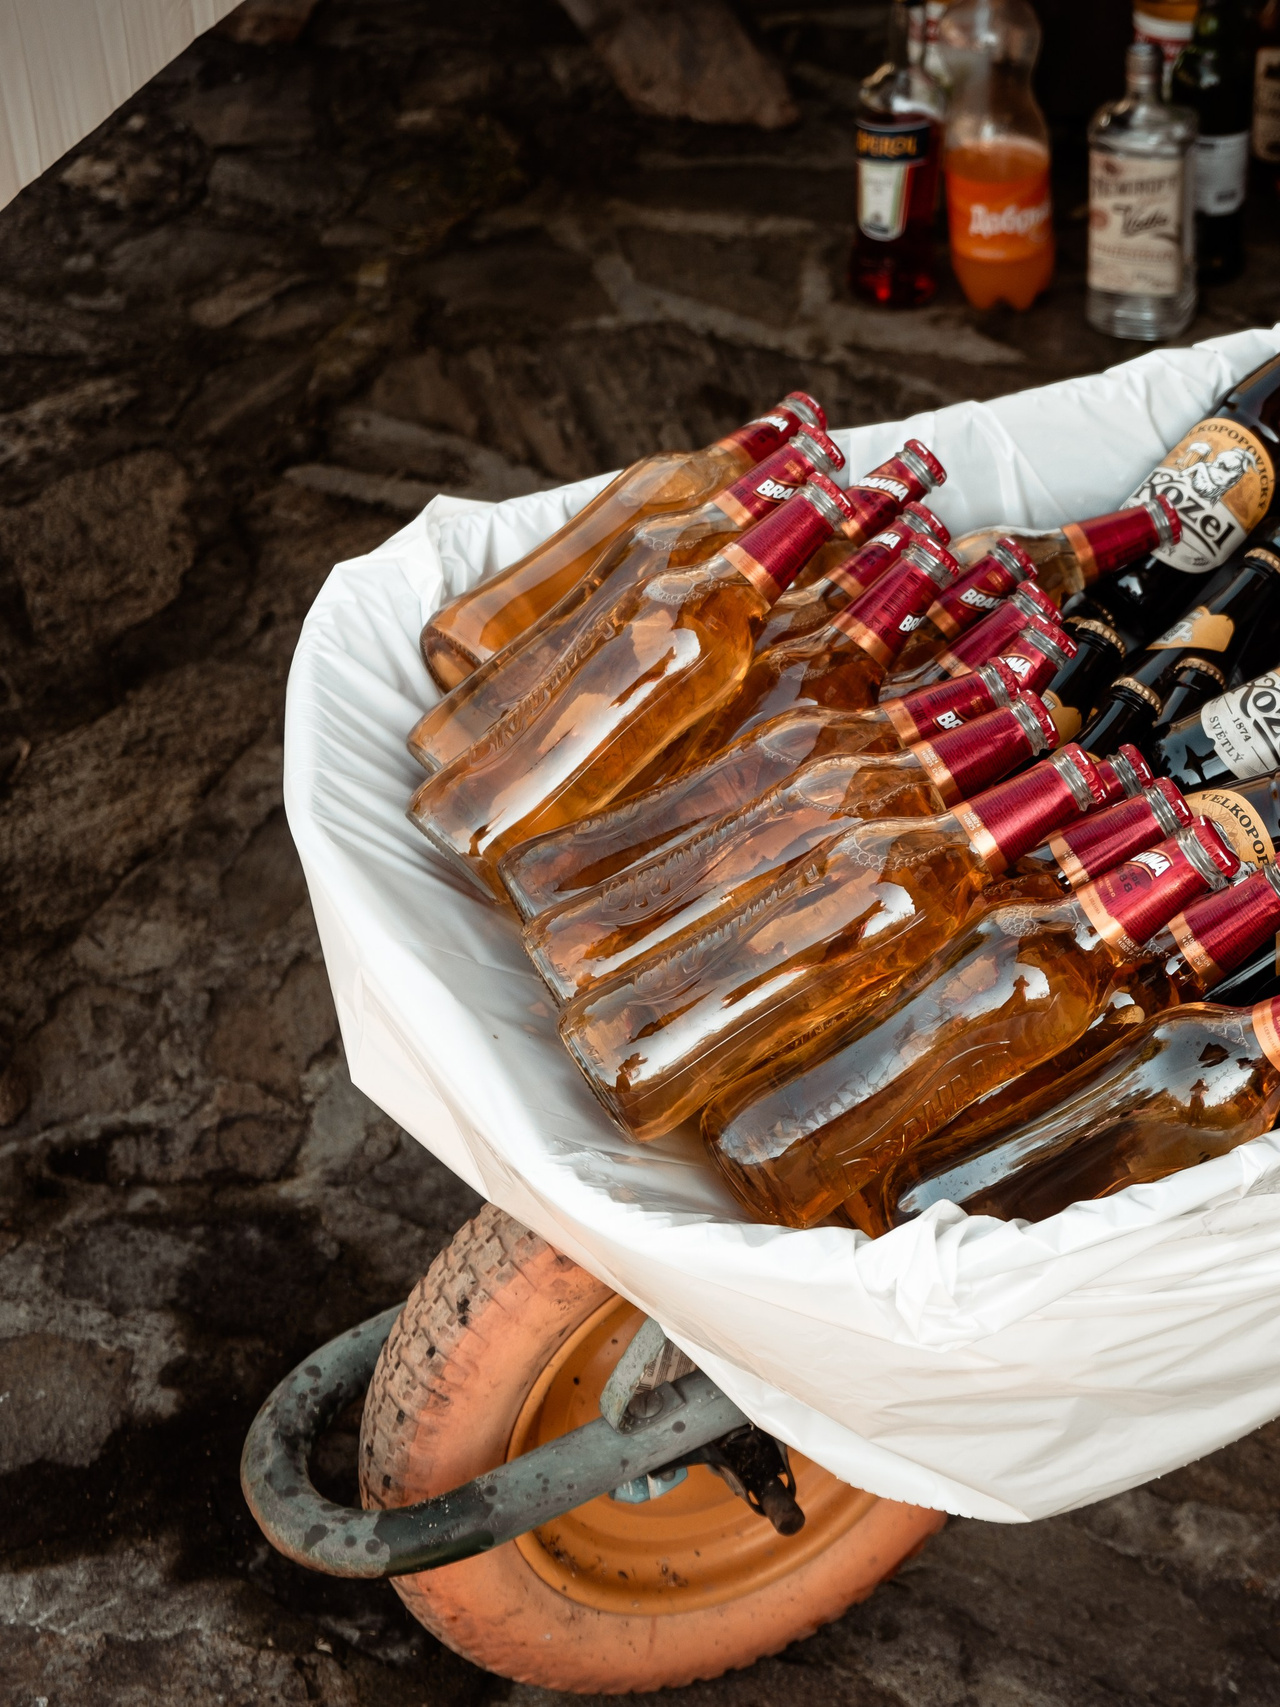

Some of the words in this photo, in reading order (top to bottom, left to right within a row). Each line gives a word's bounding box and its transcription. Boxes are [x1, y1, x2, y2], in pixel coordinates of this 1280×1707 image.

[756, 479, 797, 500] BRA
[960, 588, 1001, 610] BRAH
[1232, 717, 1252, 743] 1874
[1201, 794, 1270, 866] VELKOPOP
